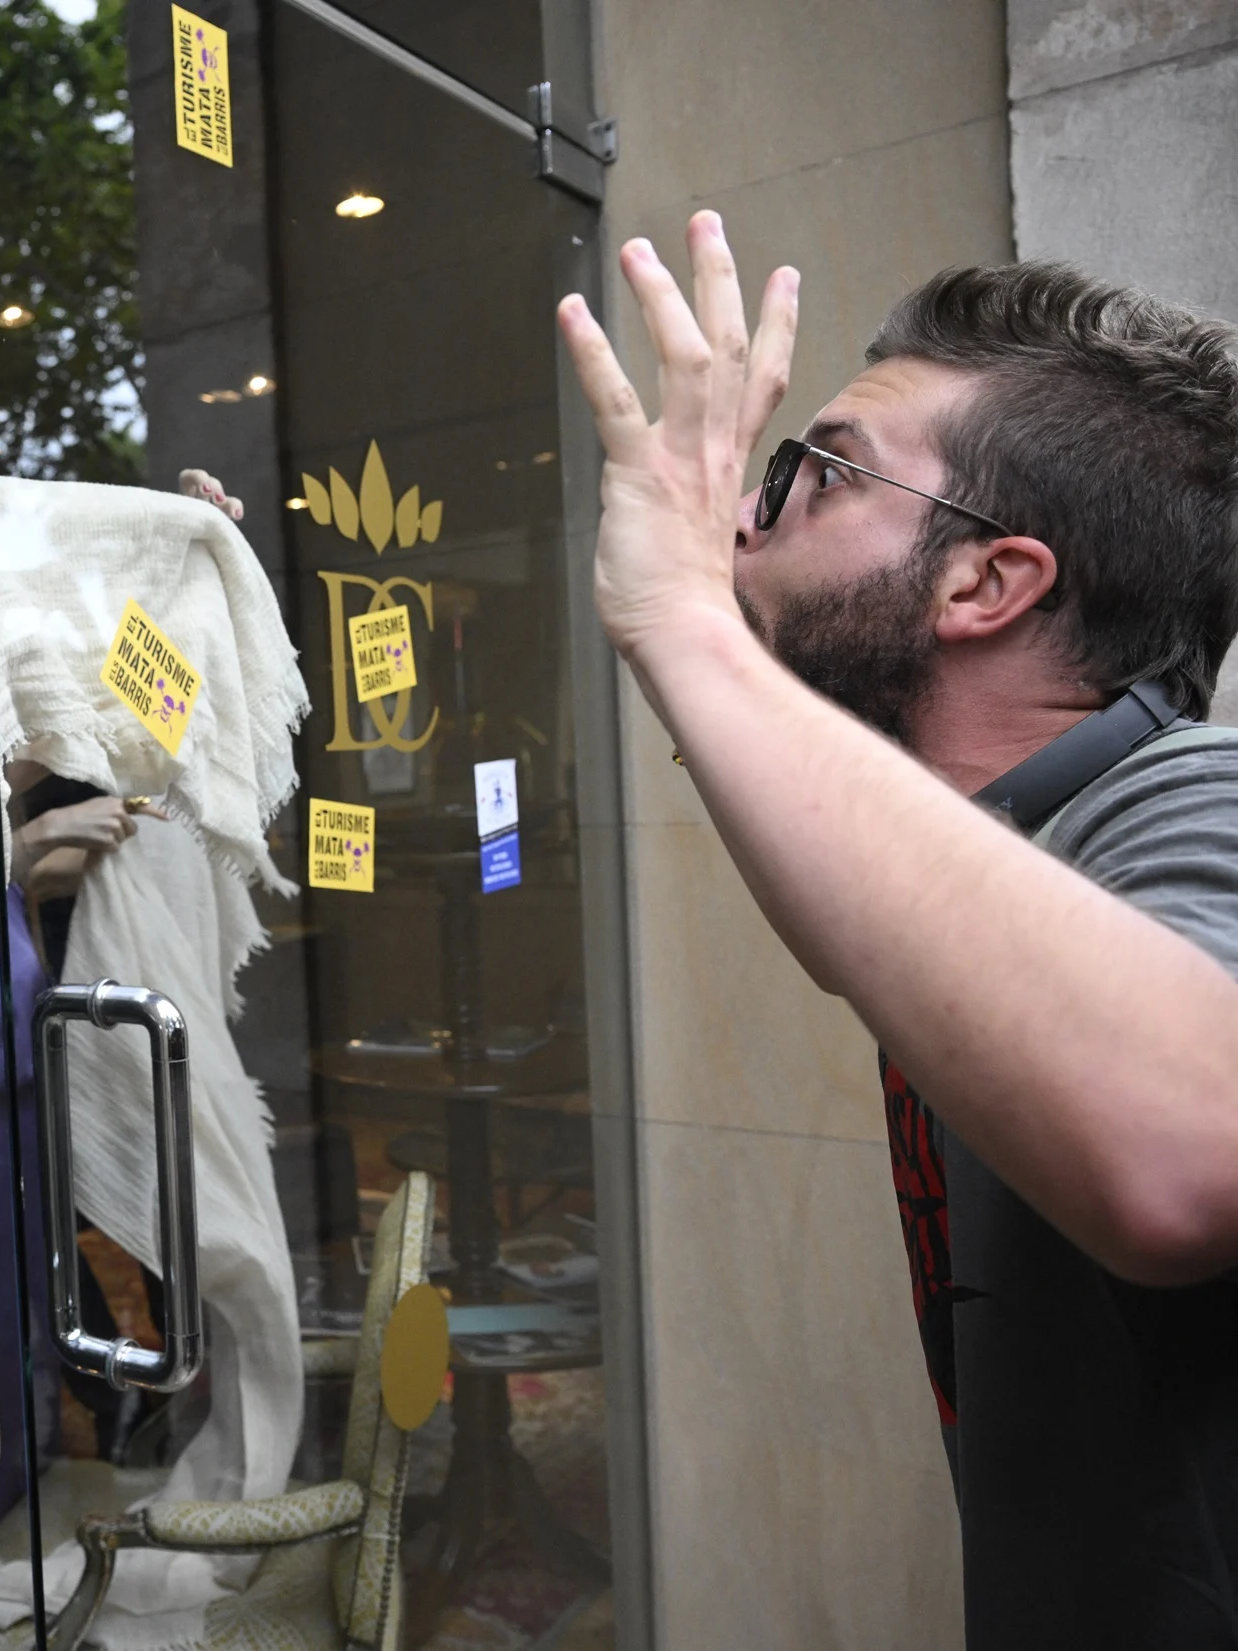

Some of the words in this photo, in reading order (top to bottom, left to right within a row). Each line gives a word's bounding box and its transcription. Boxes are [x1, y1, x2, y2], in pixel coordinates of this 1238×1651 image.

[178, 20, 196, 125] TURISME
[198, 87, 213, 150] MATA
[214, 86, 228, 146] BARRIS
[360, 614, 406, 644] TURISME
[117, 635, 155, 689] MATA
[126, 615, 139, 634] EL
[136, 620, 195, 697] TURISME
[358, 645, 387, 669] MATA
[114, 666, 152, 717] BARRIS
[364, 668, 392, 692] BARRIS
[322, 809, 370, 834] TURISME
[314, 834, 344, 856] MATA
[318, 861, 347, 882] BARRIS
